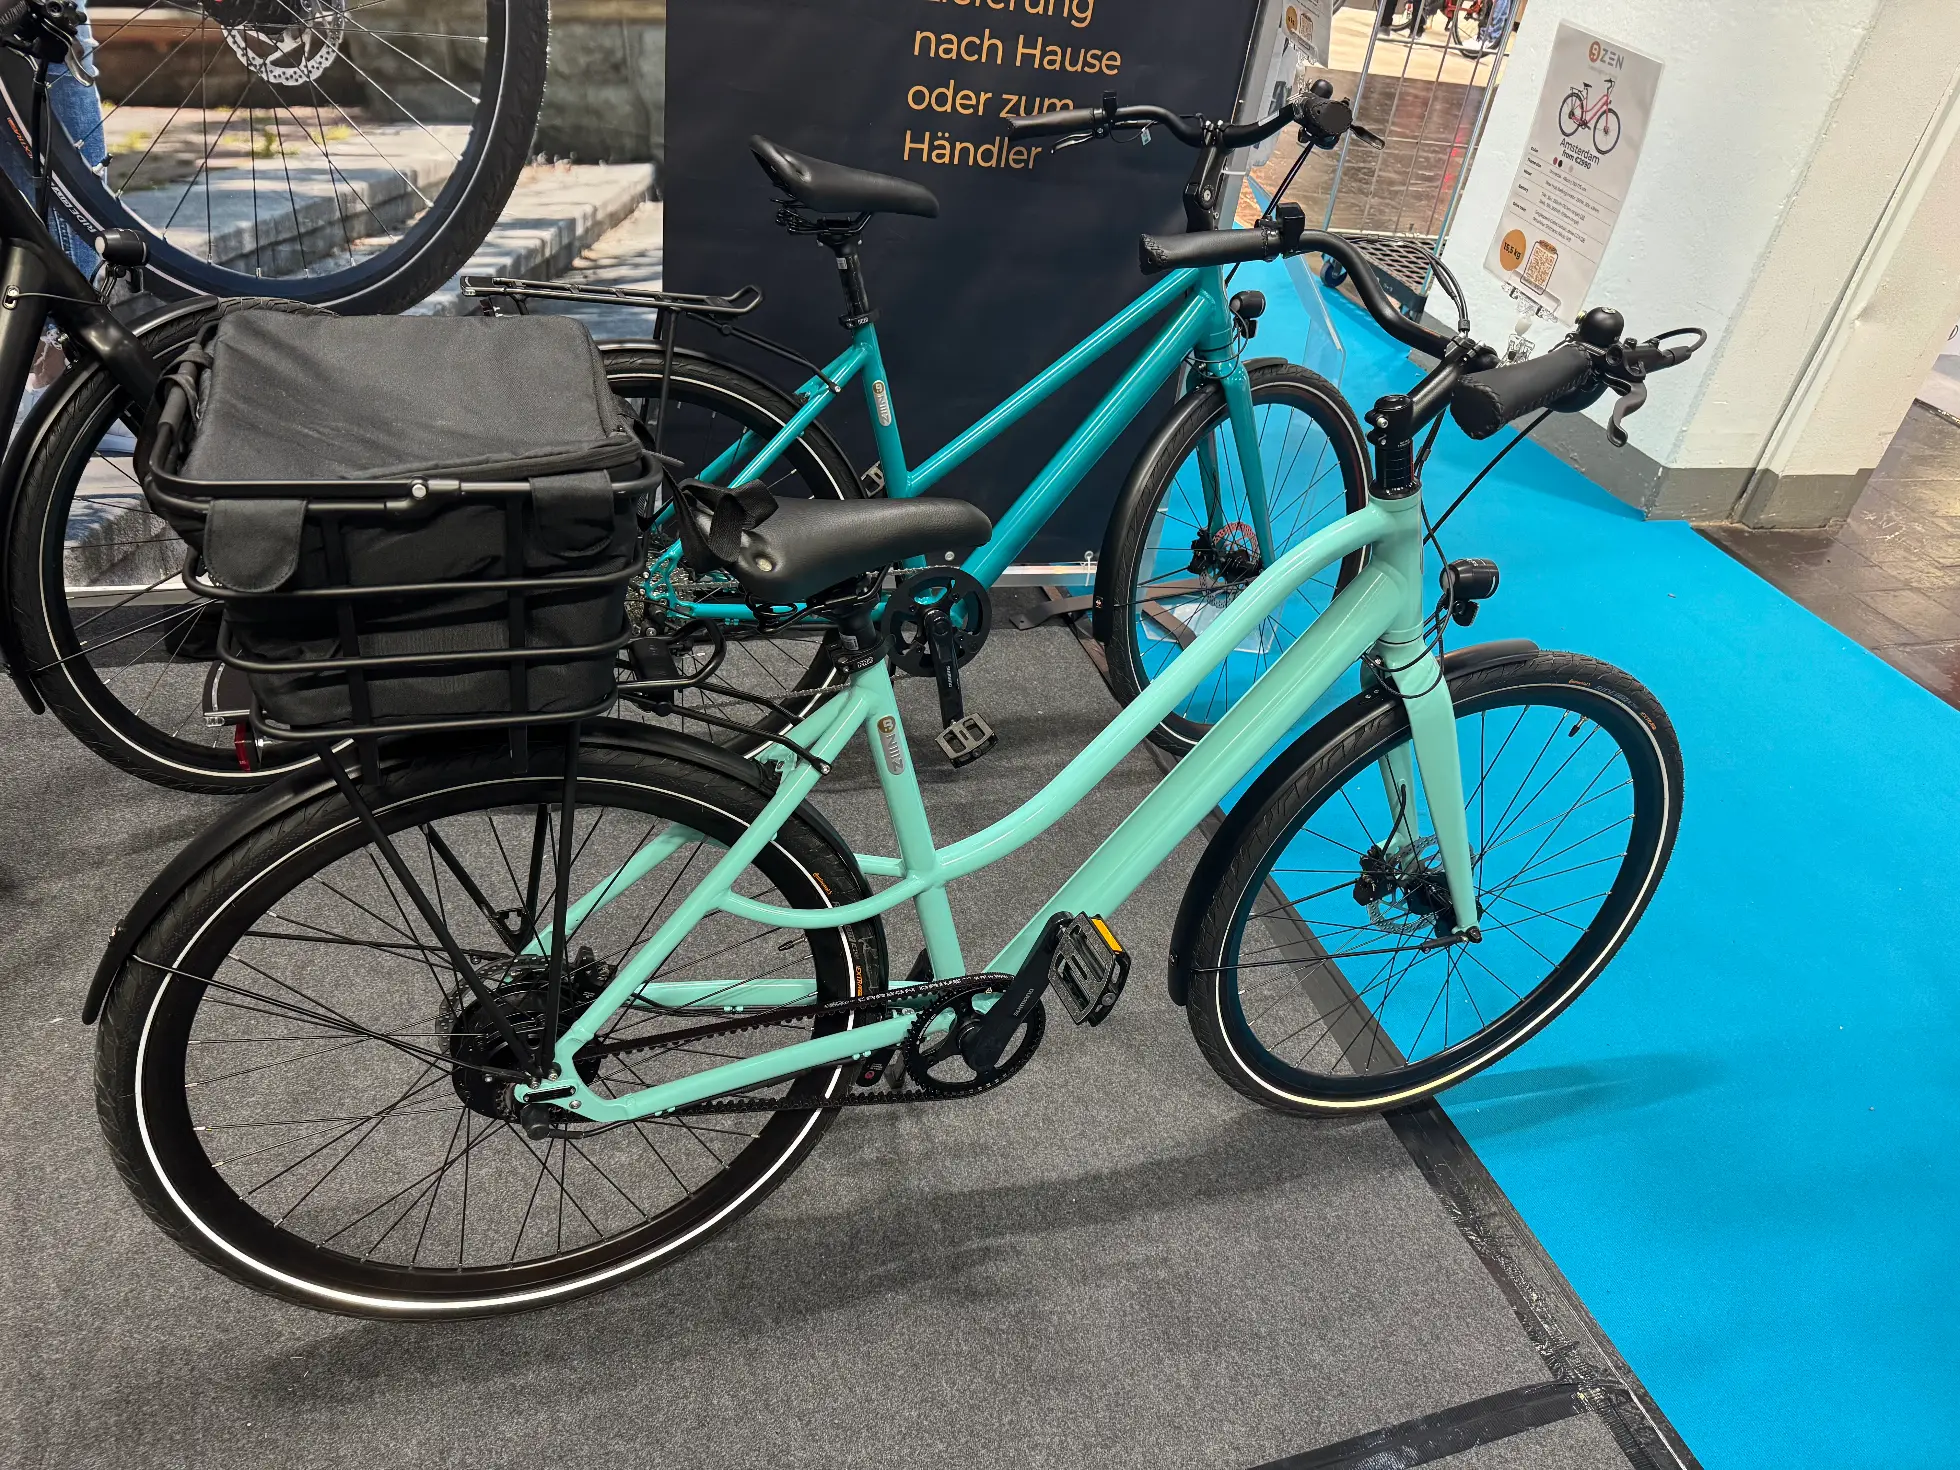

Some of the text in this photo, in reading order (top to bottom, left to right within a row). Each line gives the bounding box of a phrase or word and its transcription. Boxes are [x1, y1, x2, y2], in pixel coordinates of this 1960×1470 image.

[913, 29, 1121, 75] nach Hause
[907, 80, 1074, 118] oder zum
[903, 130, 1042, 169] Händler
[1559, 137, 1600, 166] Amsterdam
